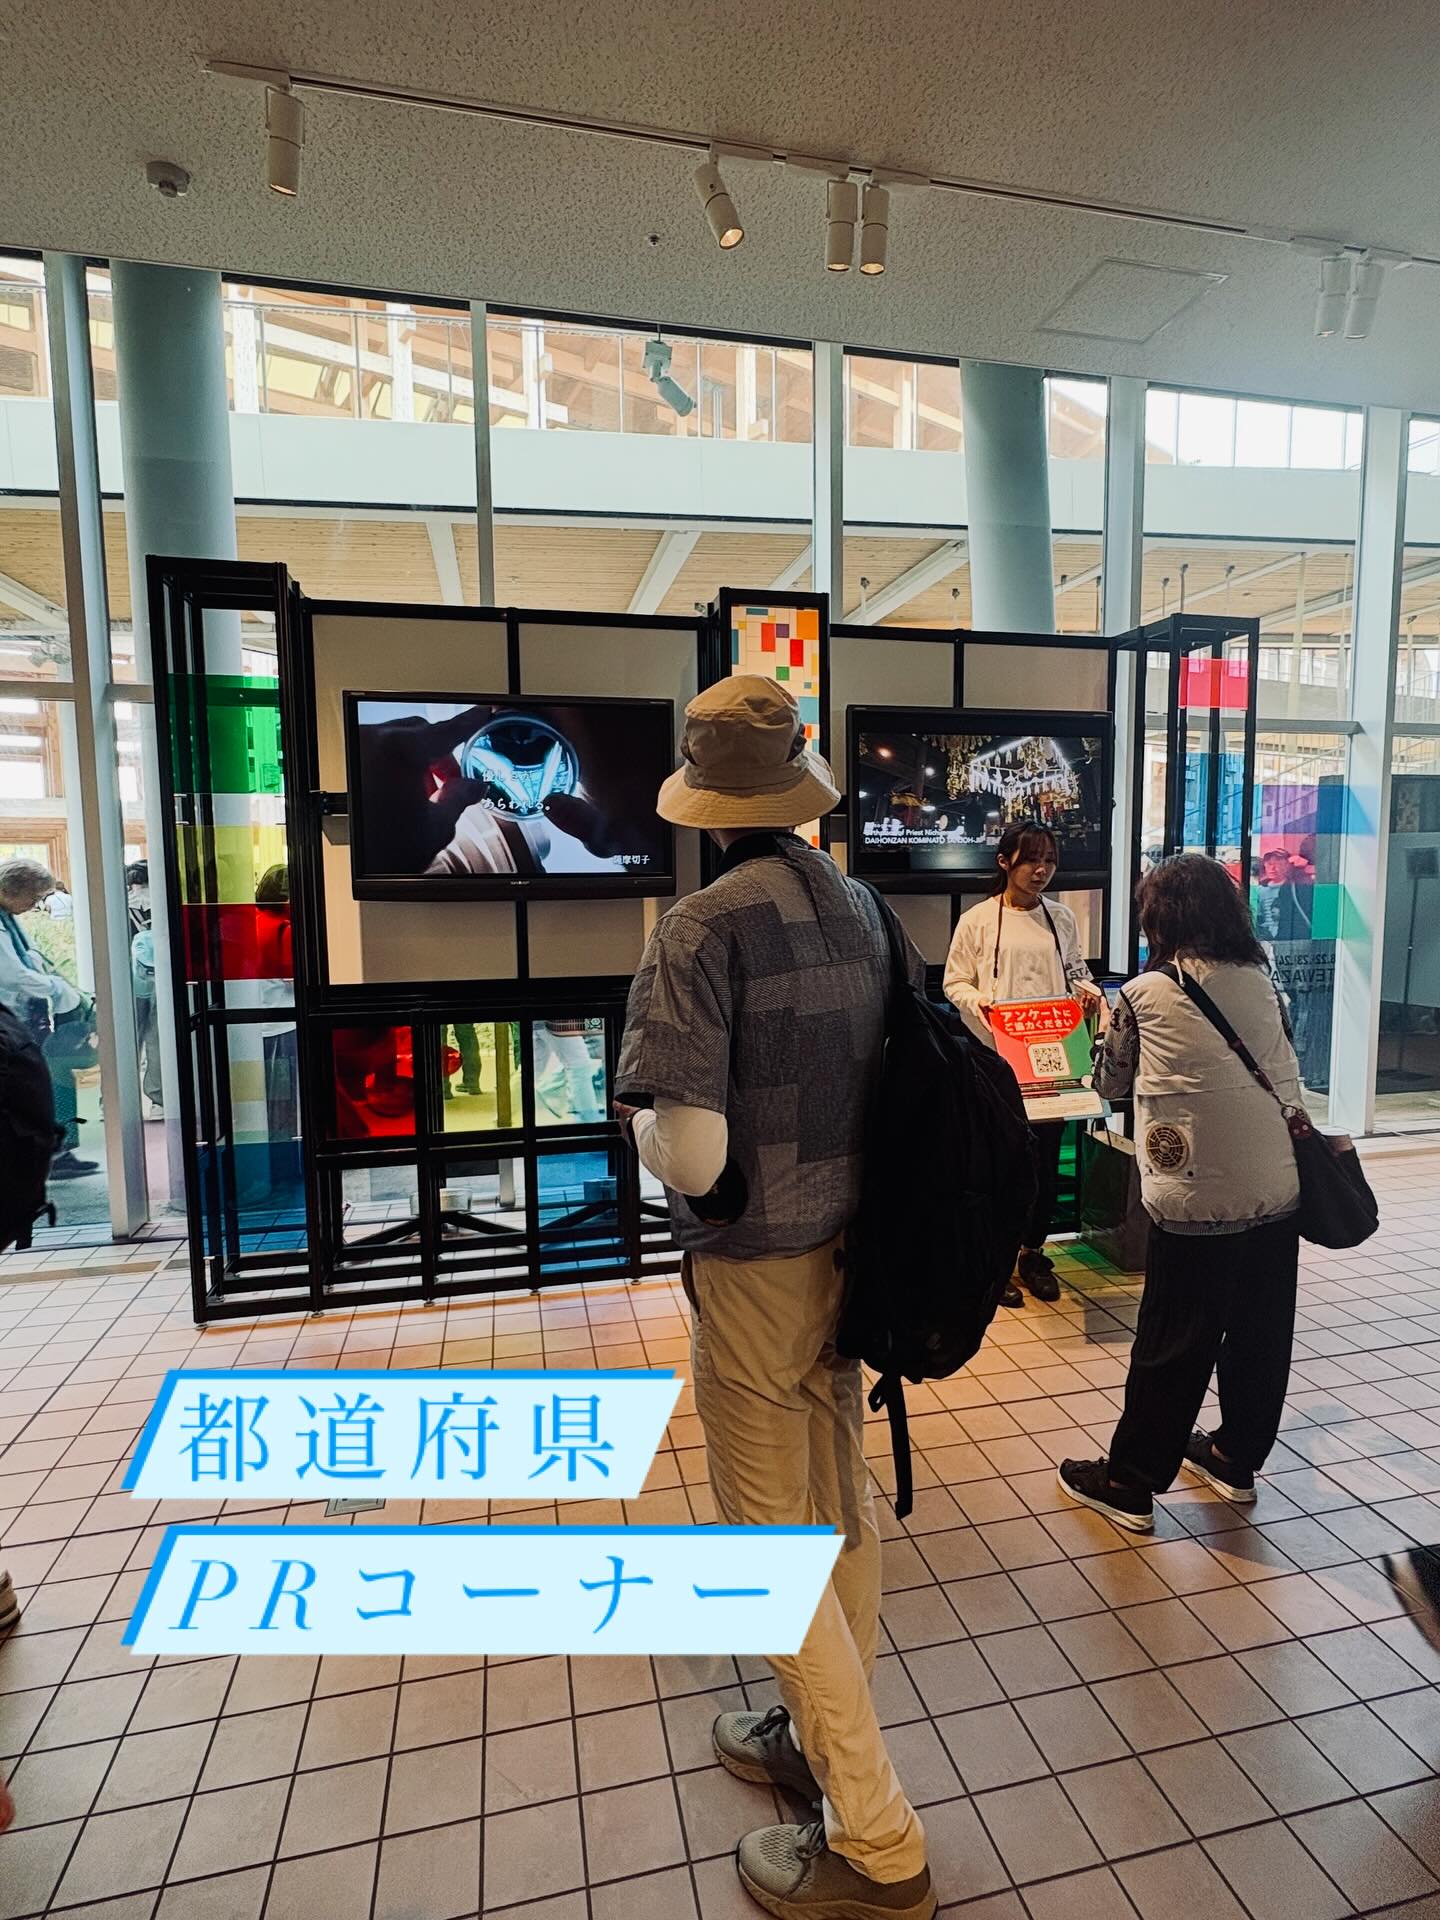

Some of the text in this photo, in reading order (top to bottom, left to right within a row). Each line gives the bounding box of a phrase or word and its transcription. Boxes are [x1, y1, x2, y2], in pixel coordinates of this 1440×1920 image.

[1000, 1006, 1072, 1023] アンケートに
[1004, 1018, 1073, 1032] ご協力ください
